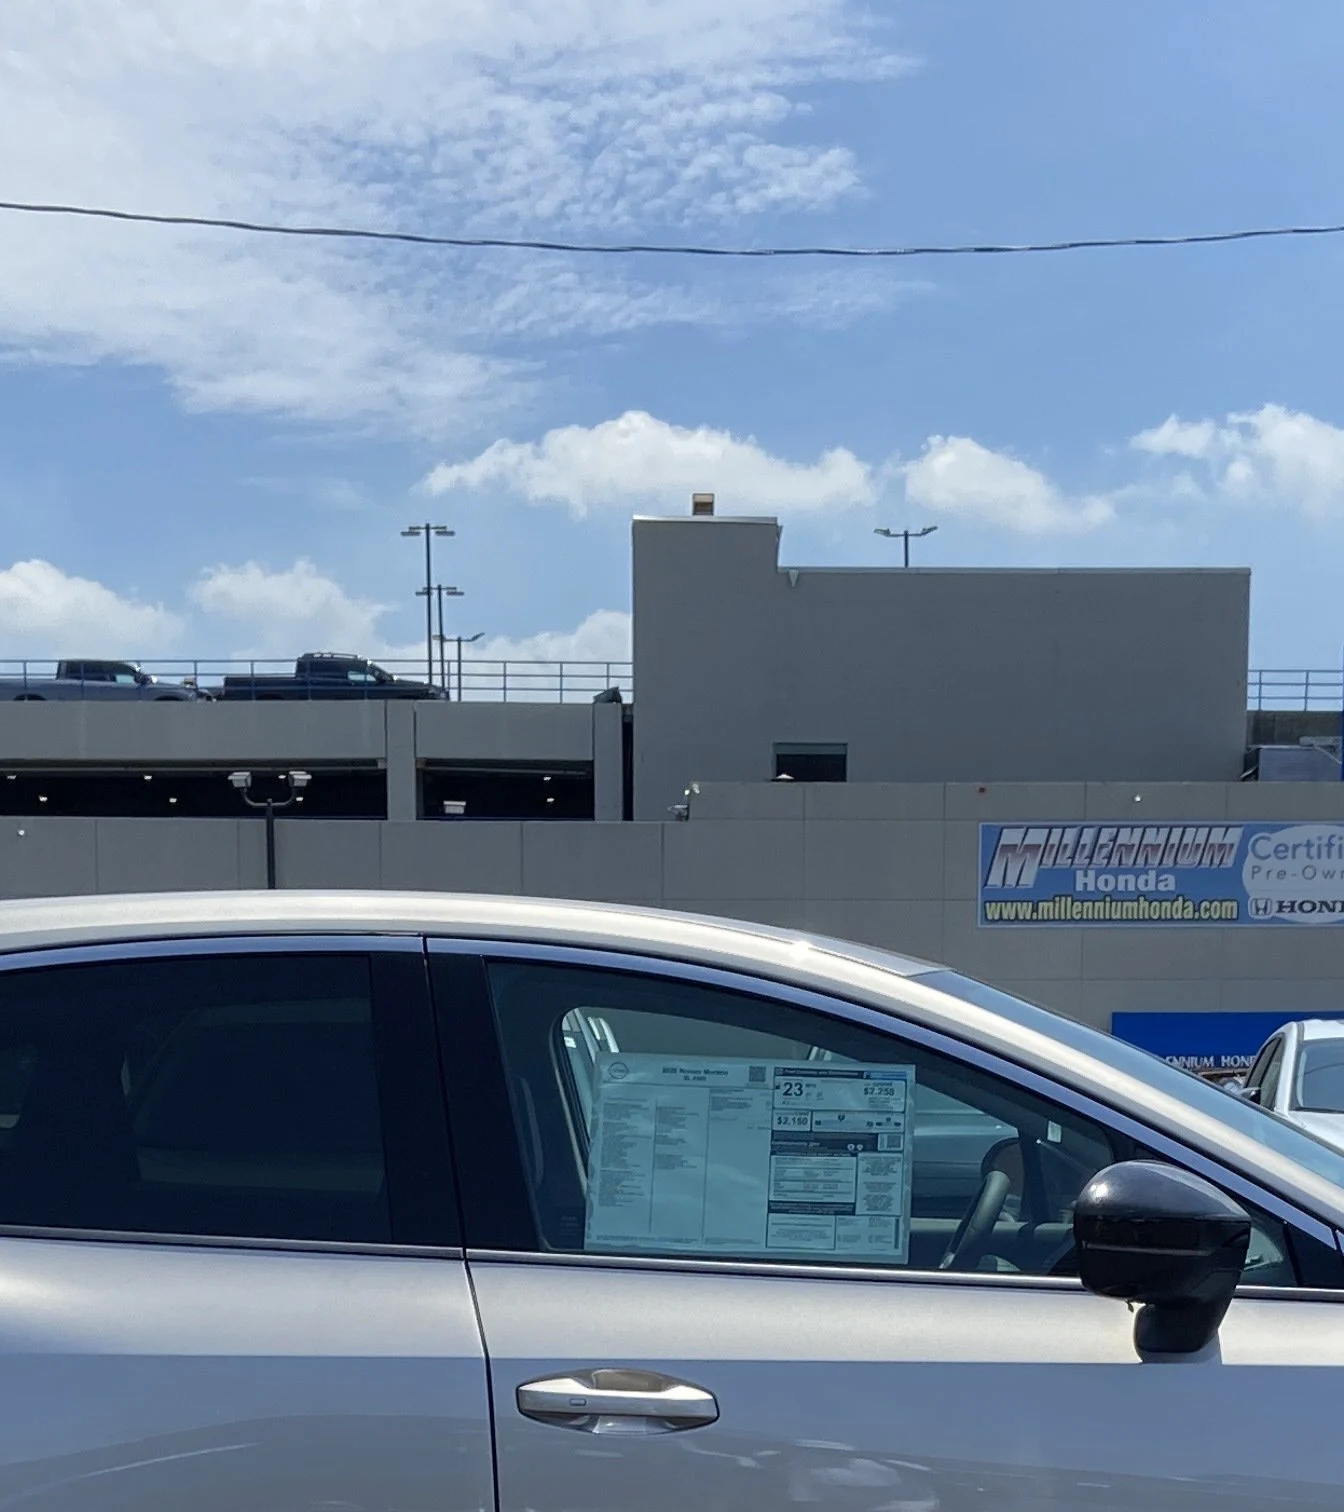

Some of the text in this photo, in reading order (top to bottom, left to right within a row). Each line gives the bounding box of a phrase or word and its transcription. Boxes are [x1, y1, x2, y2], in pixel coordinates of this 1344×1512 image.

[1075, 870, 1176, 892] Honda
[985, 896, 1238, 921] www.millenniumhonda.com
[782, 1082, 803, 1096] 23
